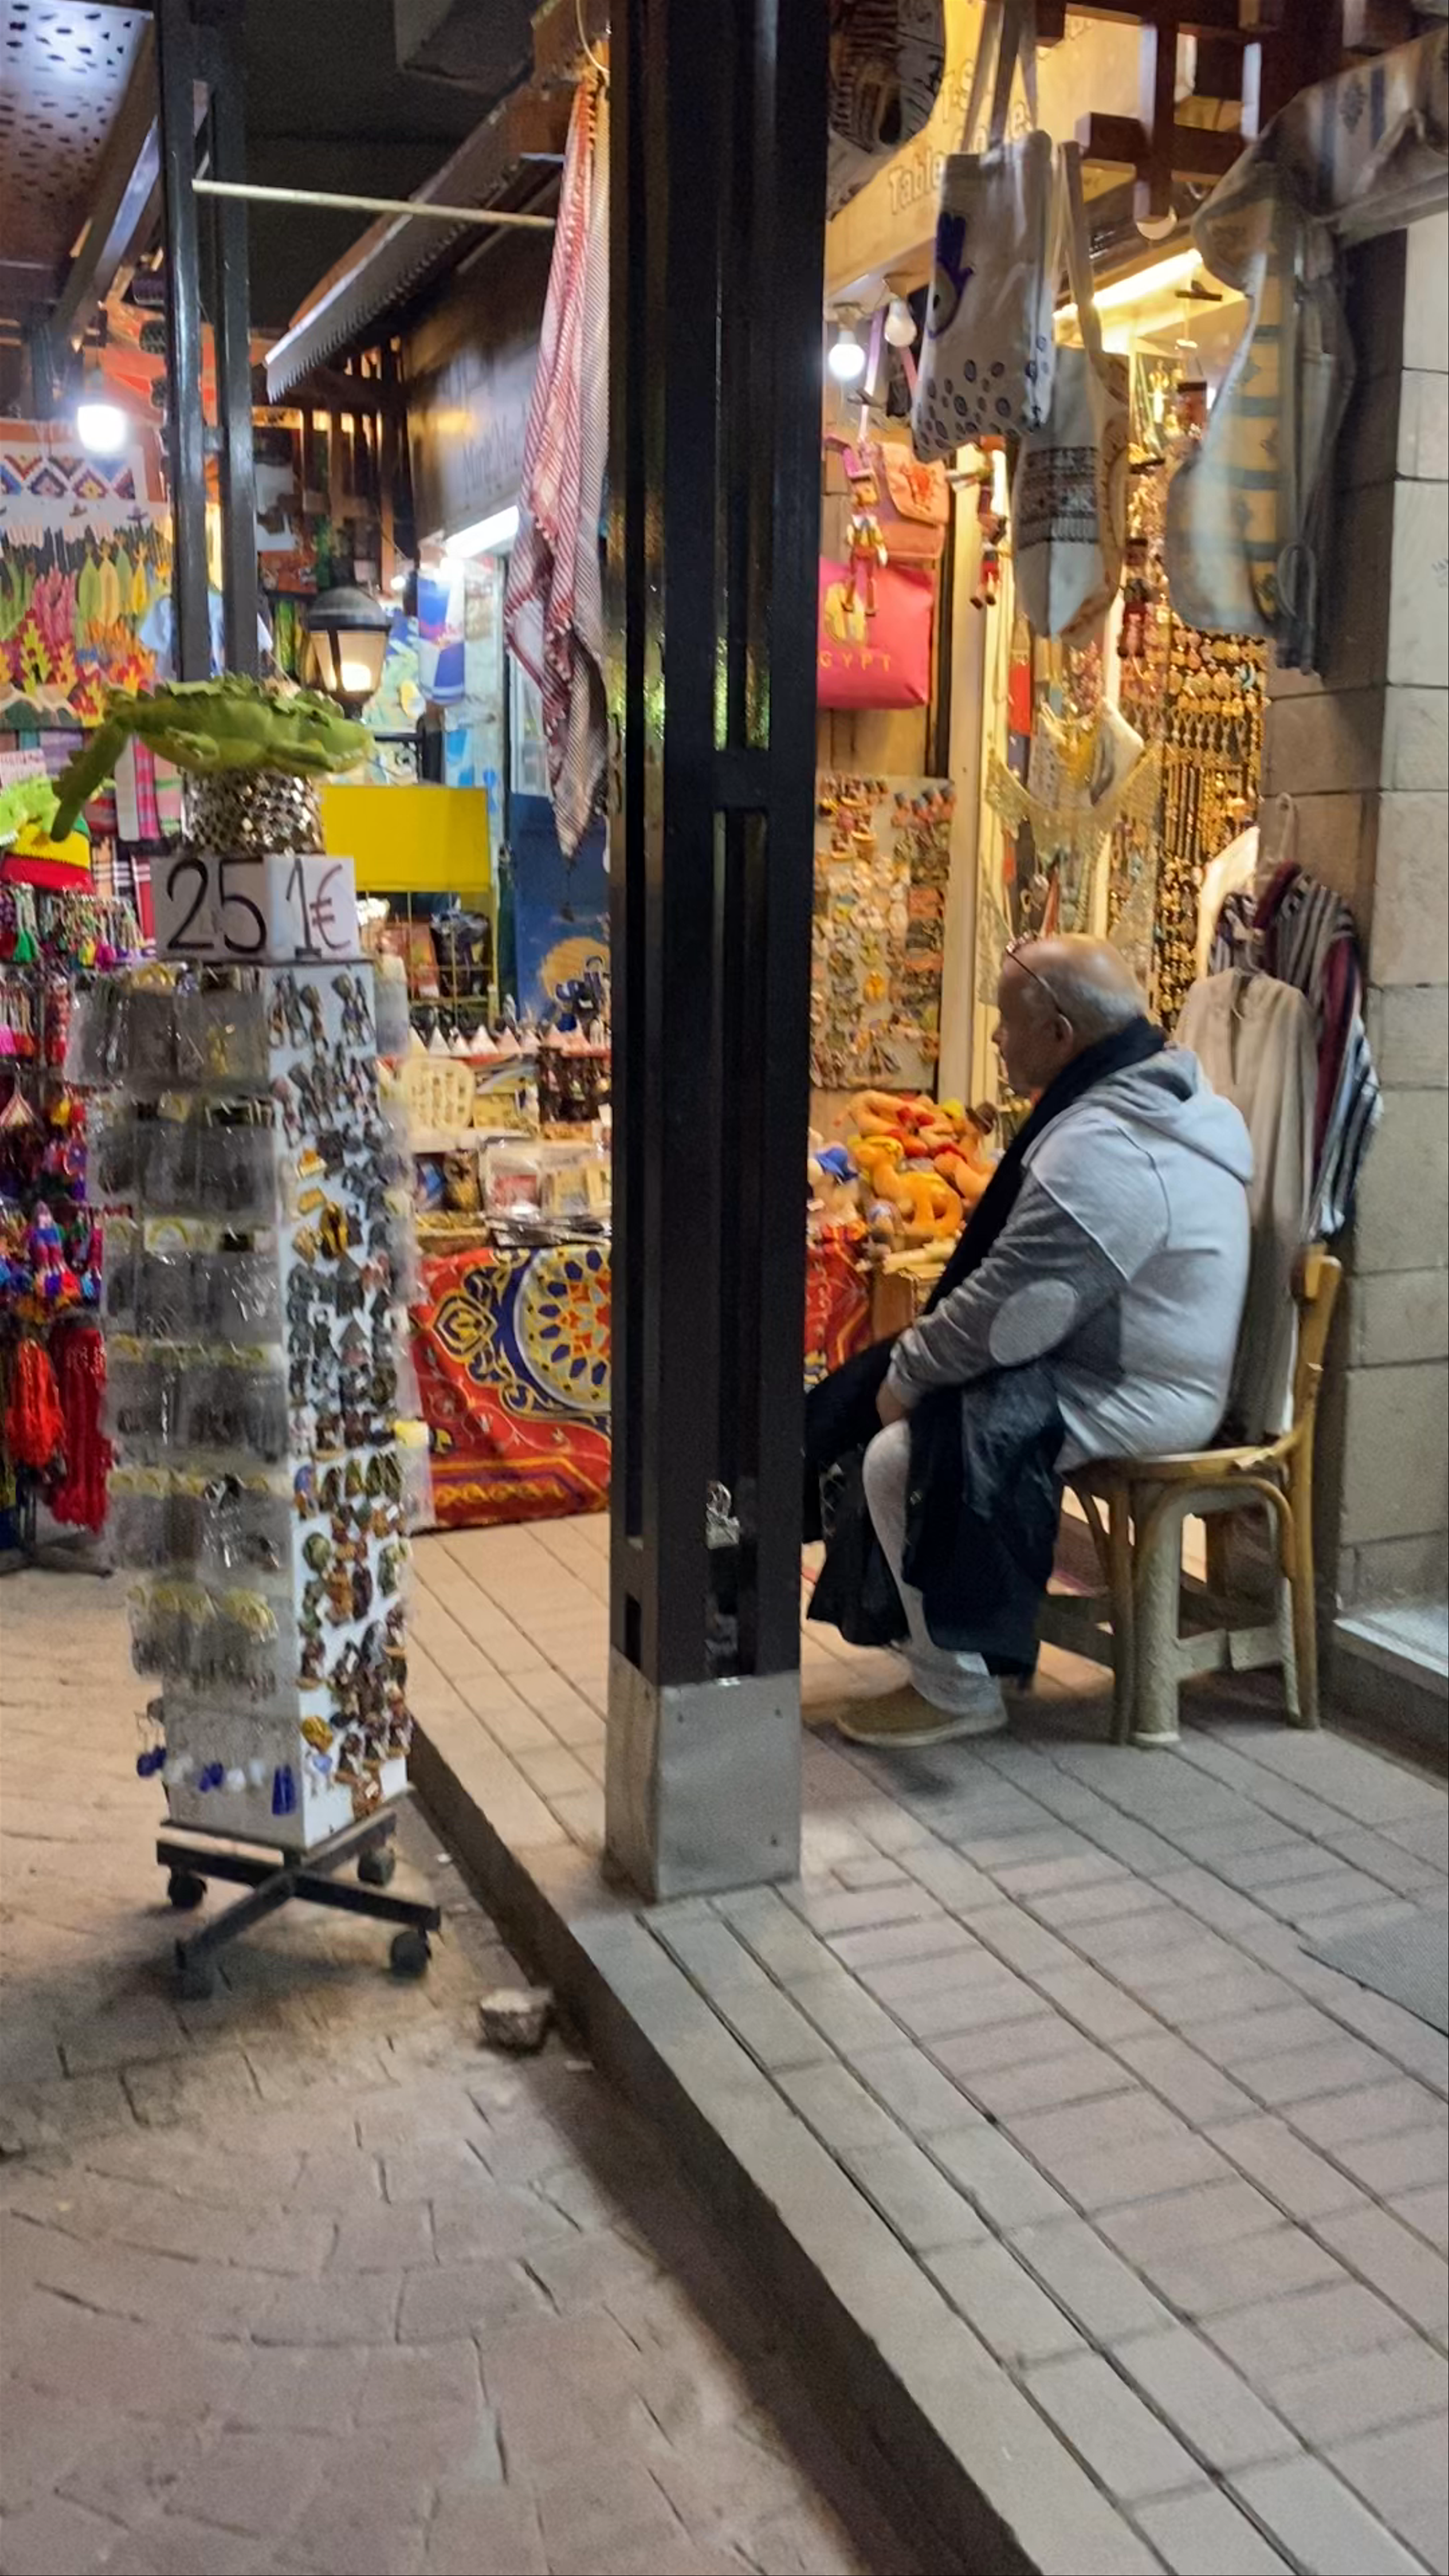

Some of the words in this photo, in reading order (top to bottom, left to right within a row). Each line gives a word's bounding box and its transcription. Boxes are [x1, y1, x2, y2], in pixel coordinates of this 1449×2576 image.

[819, 650, 891, 672] GYPT
[167, 858, 267, 954] 25
[286, 857, 351, 962] 1€
